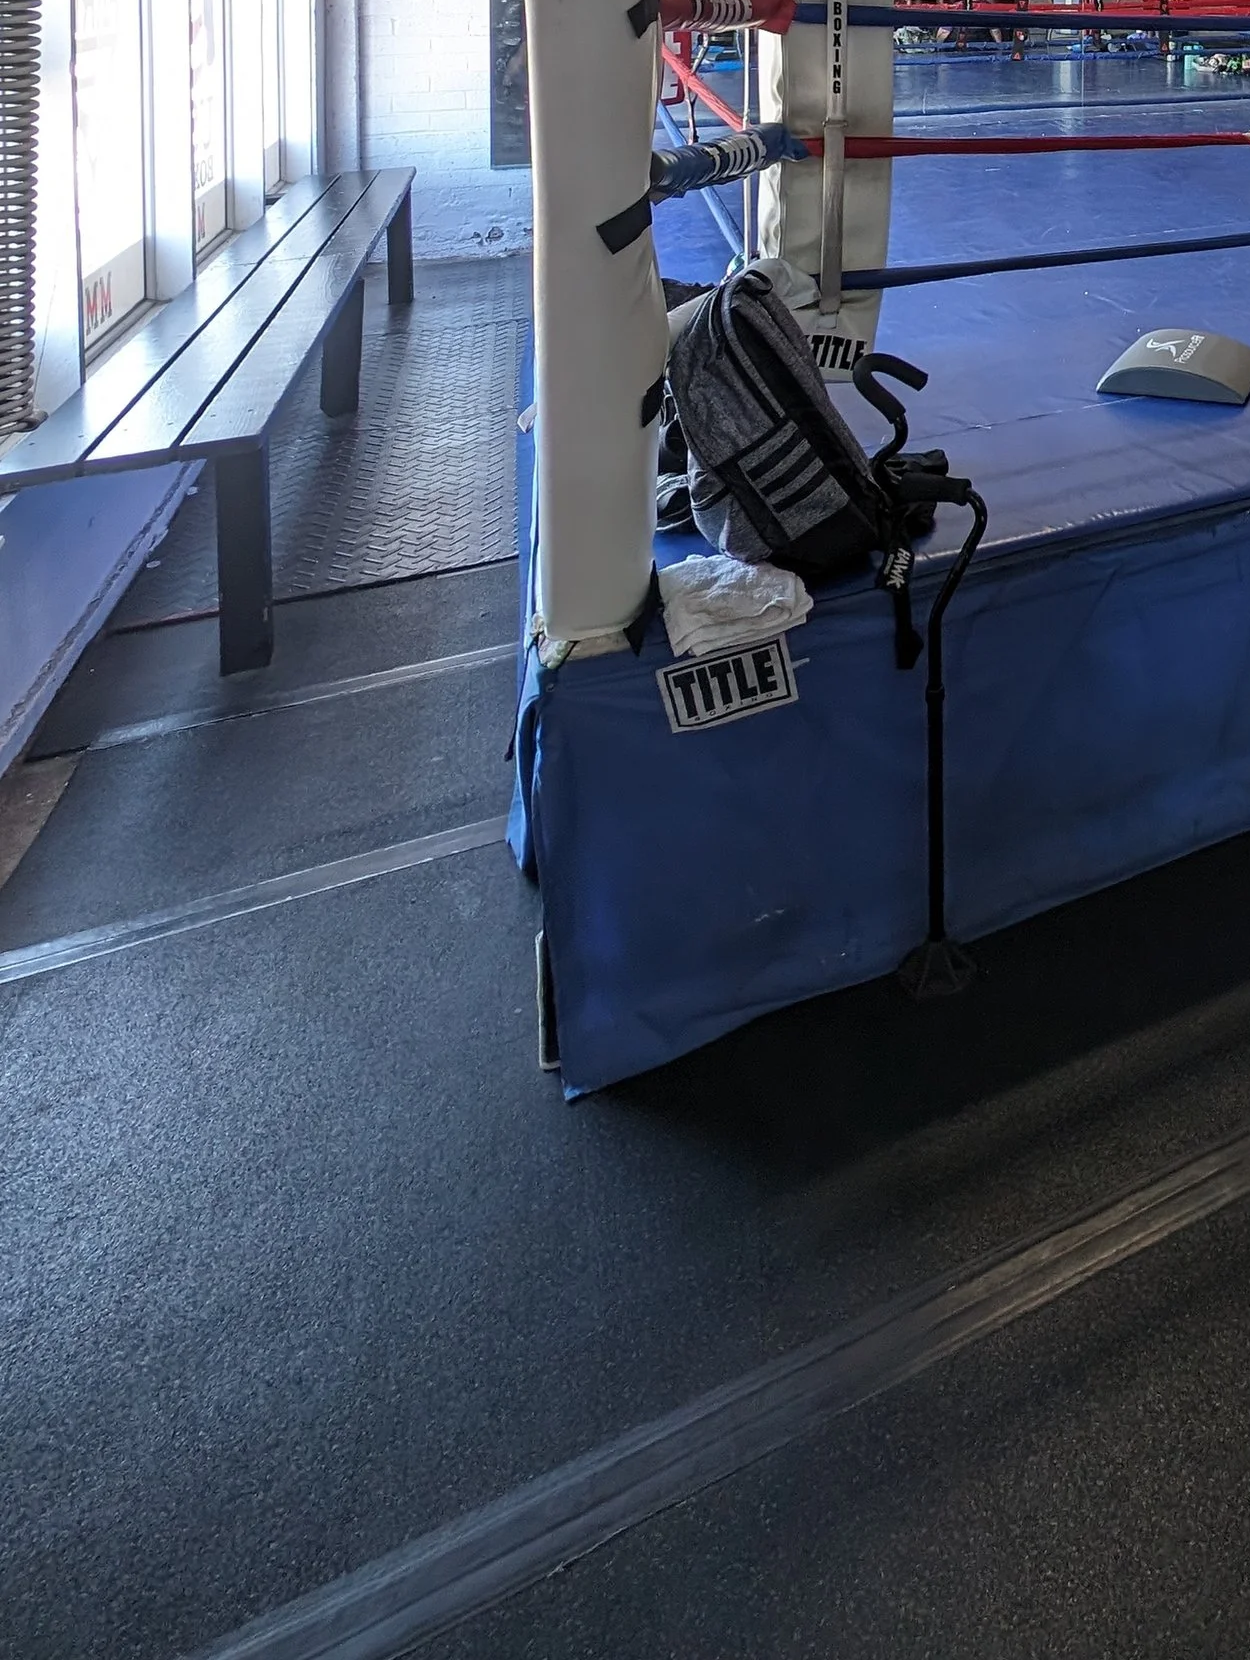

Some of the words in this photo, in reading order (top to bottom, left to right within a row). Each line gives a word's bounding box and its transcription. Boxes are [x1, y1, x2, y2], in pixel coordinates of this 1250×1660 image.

[832, 0, 842, 95] BOXING
[811, 335, 867, 371] TITLE
[886, 547, 911, 589] HAWK
[671, 648, 778, 719] TITLE
[694, 692, 773, 721] BOXING
